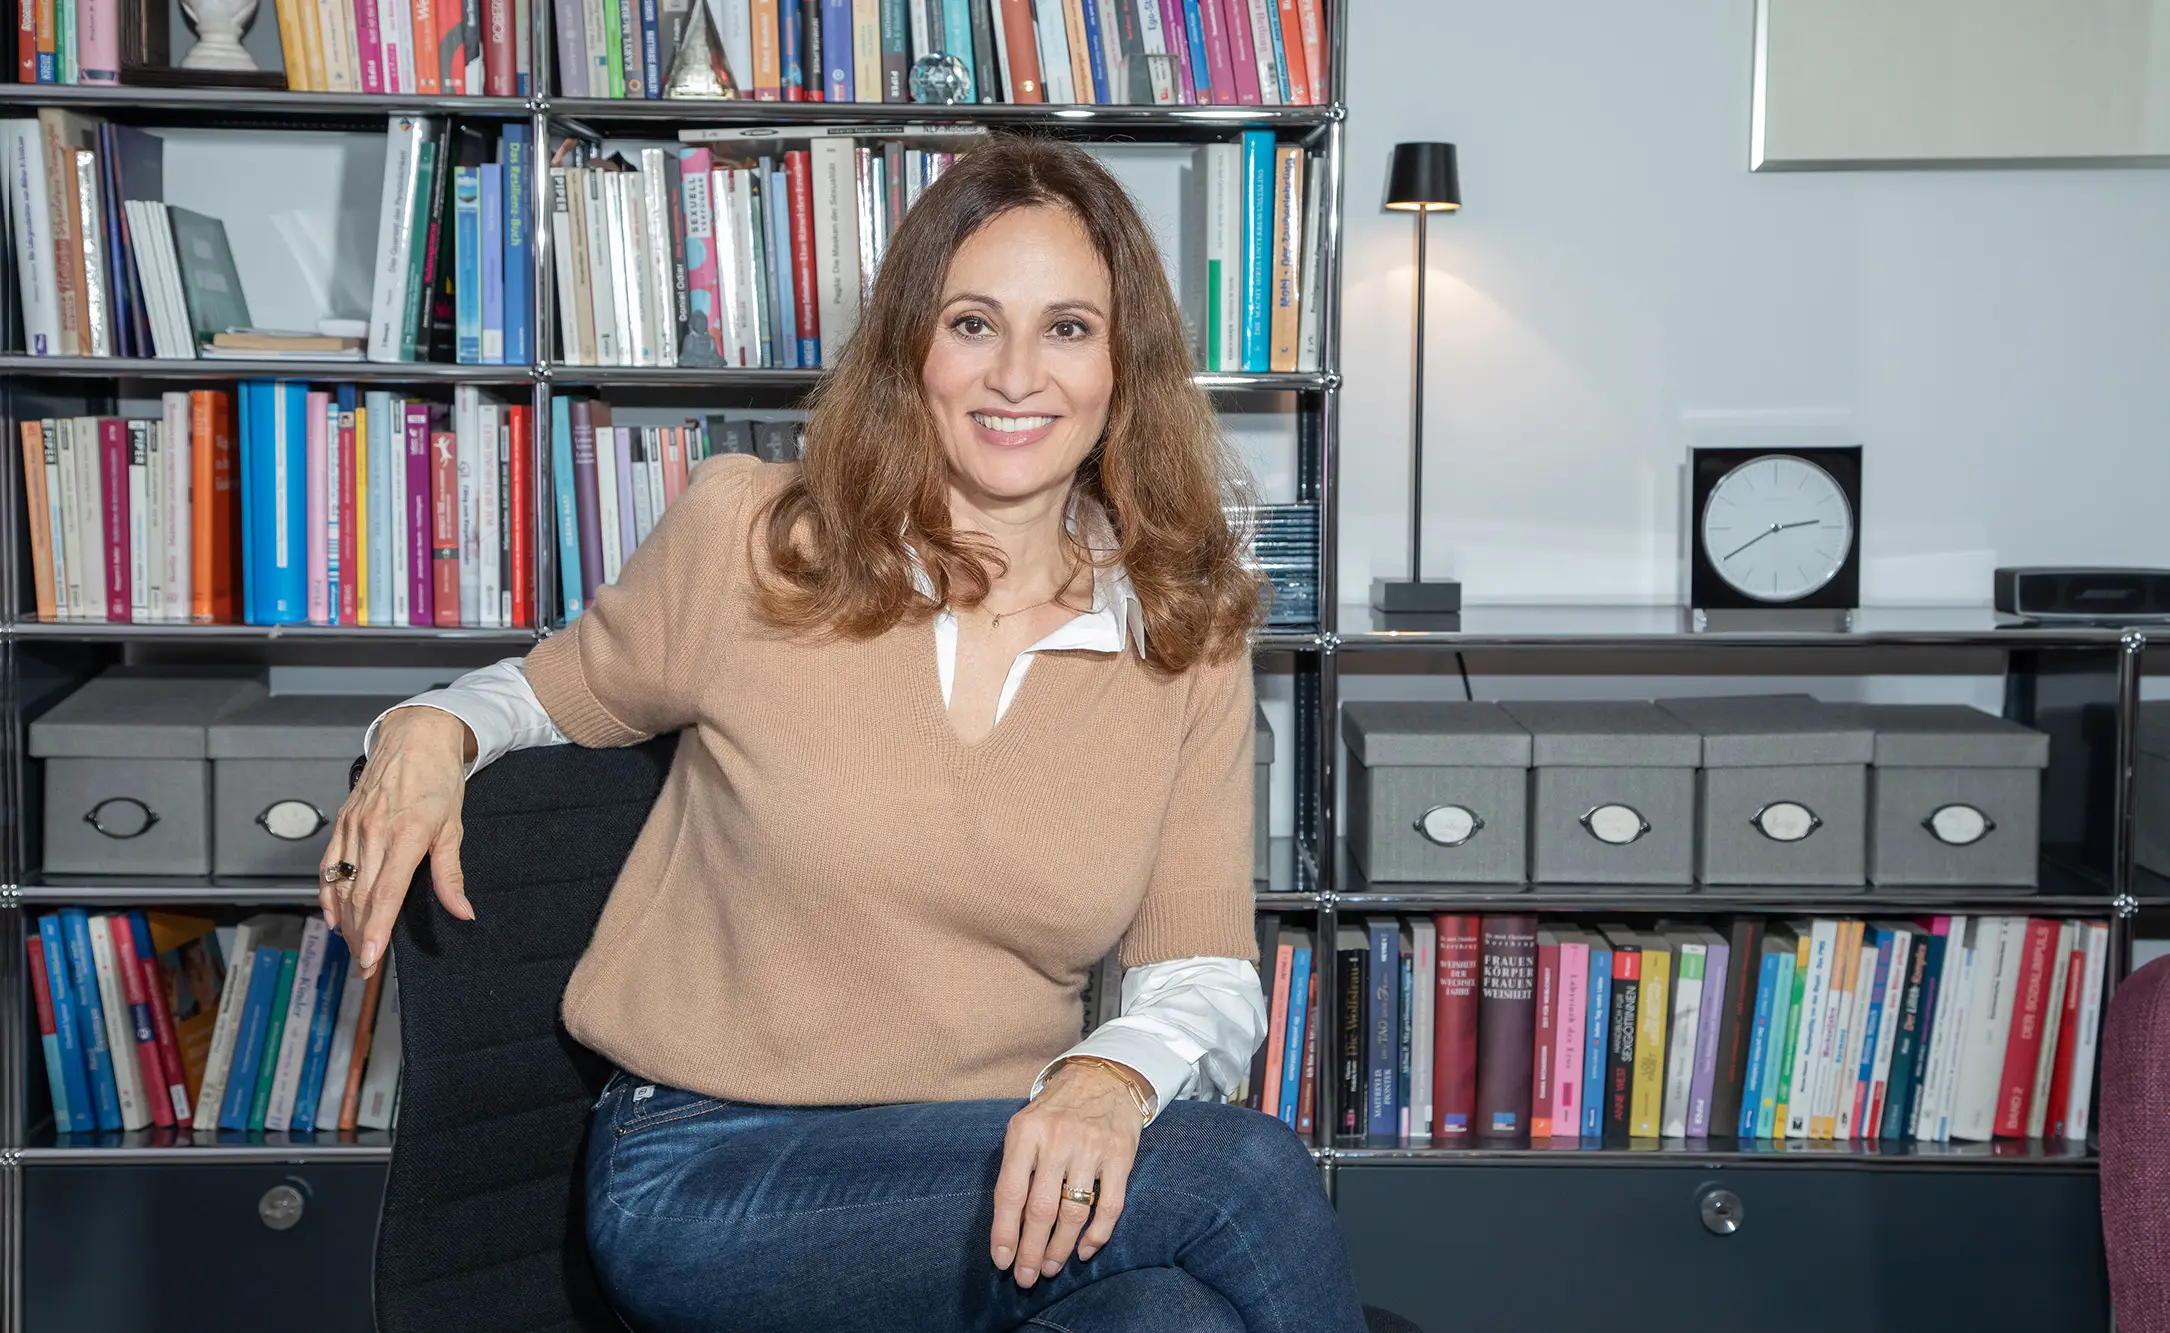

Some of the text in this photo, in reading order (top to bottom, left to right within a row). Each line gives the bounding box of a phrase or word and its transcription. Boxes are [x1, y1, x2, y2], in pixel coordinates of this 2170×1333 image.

[622, 37, 634, 71] KARYL
[890, 70, 900, 97] PIPER
[509, 142, 521, 246] Das Resilienz-Buch
[555, 177, 567, 211] PIPER
[828, 162, 837, 205] Sexualität
[388, 150, 406, 273] Das Quartett der Persönlichkeit
[687, 178, 699, 234] SEXUELL
[698, 177, 706, 232] VERFÜGBAR
[796, 196, 804, 212] der
[830, 208, 838, 222] der
[796, 214, 807, 240] Rätsel
[830, 224, 838, 256] Masken
[1280, 158, 1296, 307] Mohl Der Zauberlehrling
[799, 242, 808, 260] Das
[676, 264, 684, 288] Odier
[678, 292, 688, 322] Daniel
[802, 340, 815, 365] KREUZ
[44, 430, 56, 462] PIPER
[134, 431, 146, 464] PIPER
[562, 494, 572, 514] KAST
[293, 934, 319, 1017] Indigo-Kinder
[1440, 960, 1476, 968] WEISHEIT
[1450, 970, 1467, 978] DER
[1484, 955, 1533, 966] FRAUEN
[1484, 965, 1533, 978] KÖRPER
[1440, 978, 1476, 986] WECHSEL
[1483, 988, 1532, 1000] WEISHEIT
[1484, 977, 1532, 988] FRAUEN
[1905, 944, 1928, 1014] Lilith-Komplex
[1345, 967, 1360, 1056] Die Wolfsfrau
[1565, 974, 1578, 1070] Labyrinth des Eros
[1614, 993, 1624, 1054] HANDBUCH FÜR
[1622, 986, 1636, 1062] SEXGÖTTINNEN
[1904, 1014, 1915, 1032] Der
[91, 1008, 105, 1052] Postman
[1377, 1020, 1388, 1044] TAO
[1823, 1006, 1836, 1058] Wechseljahre
[2006, 926, 2050, 1130] BAND 2 DER SOZIALIMPULS
[1835, 1028, 1847, 1064] Hormone
[1614, 1068, 1626, 1121] ANNE WEST
[1695, 1098, 1704, 1126] PIPER
